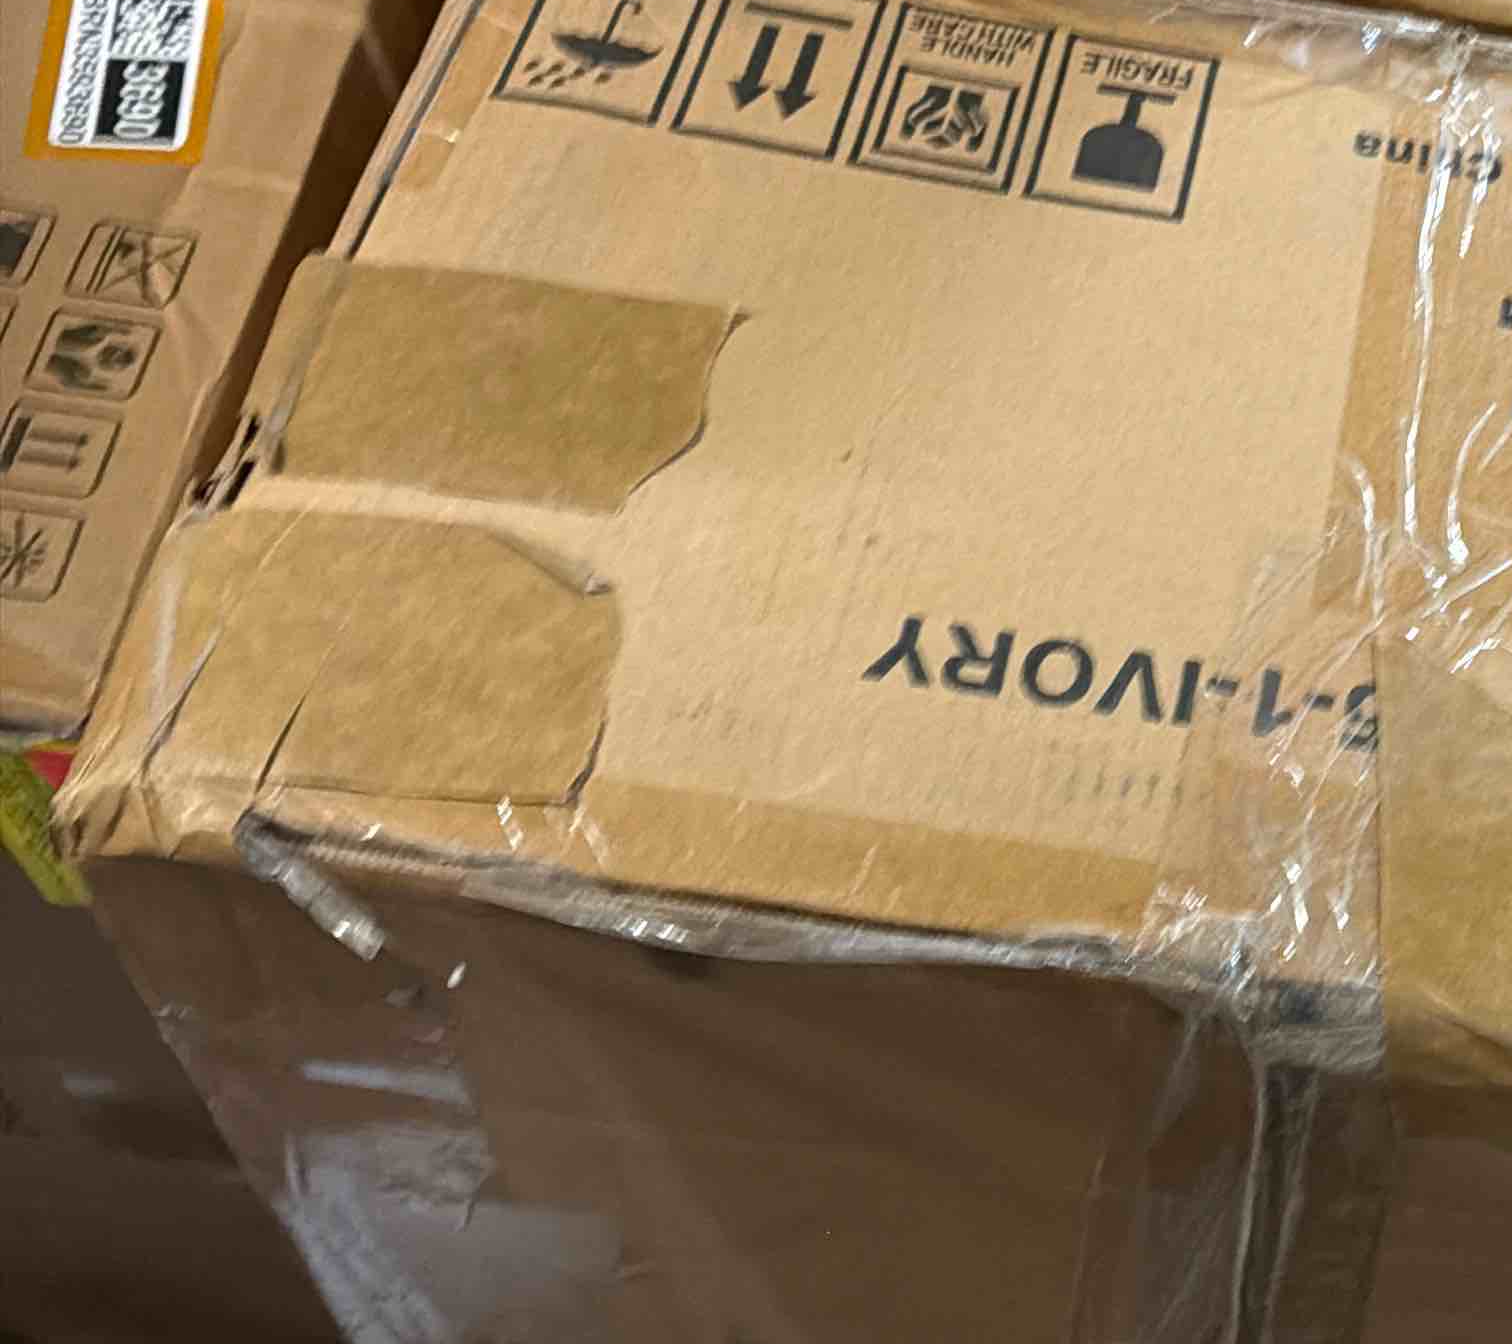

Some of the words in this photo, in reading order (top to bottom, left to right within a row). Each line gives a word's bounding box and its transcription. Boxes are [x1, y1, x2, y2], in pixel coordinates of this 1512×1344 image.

[910, 9, 974, 44] CARE
[970, 22, 1037, 54] WITH
[920, 32, 1018, 68] HANDLE
[1080, 50, 1197, 91] FRAGILE
[1353, 128, 1503, 187] China
